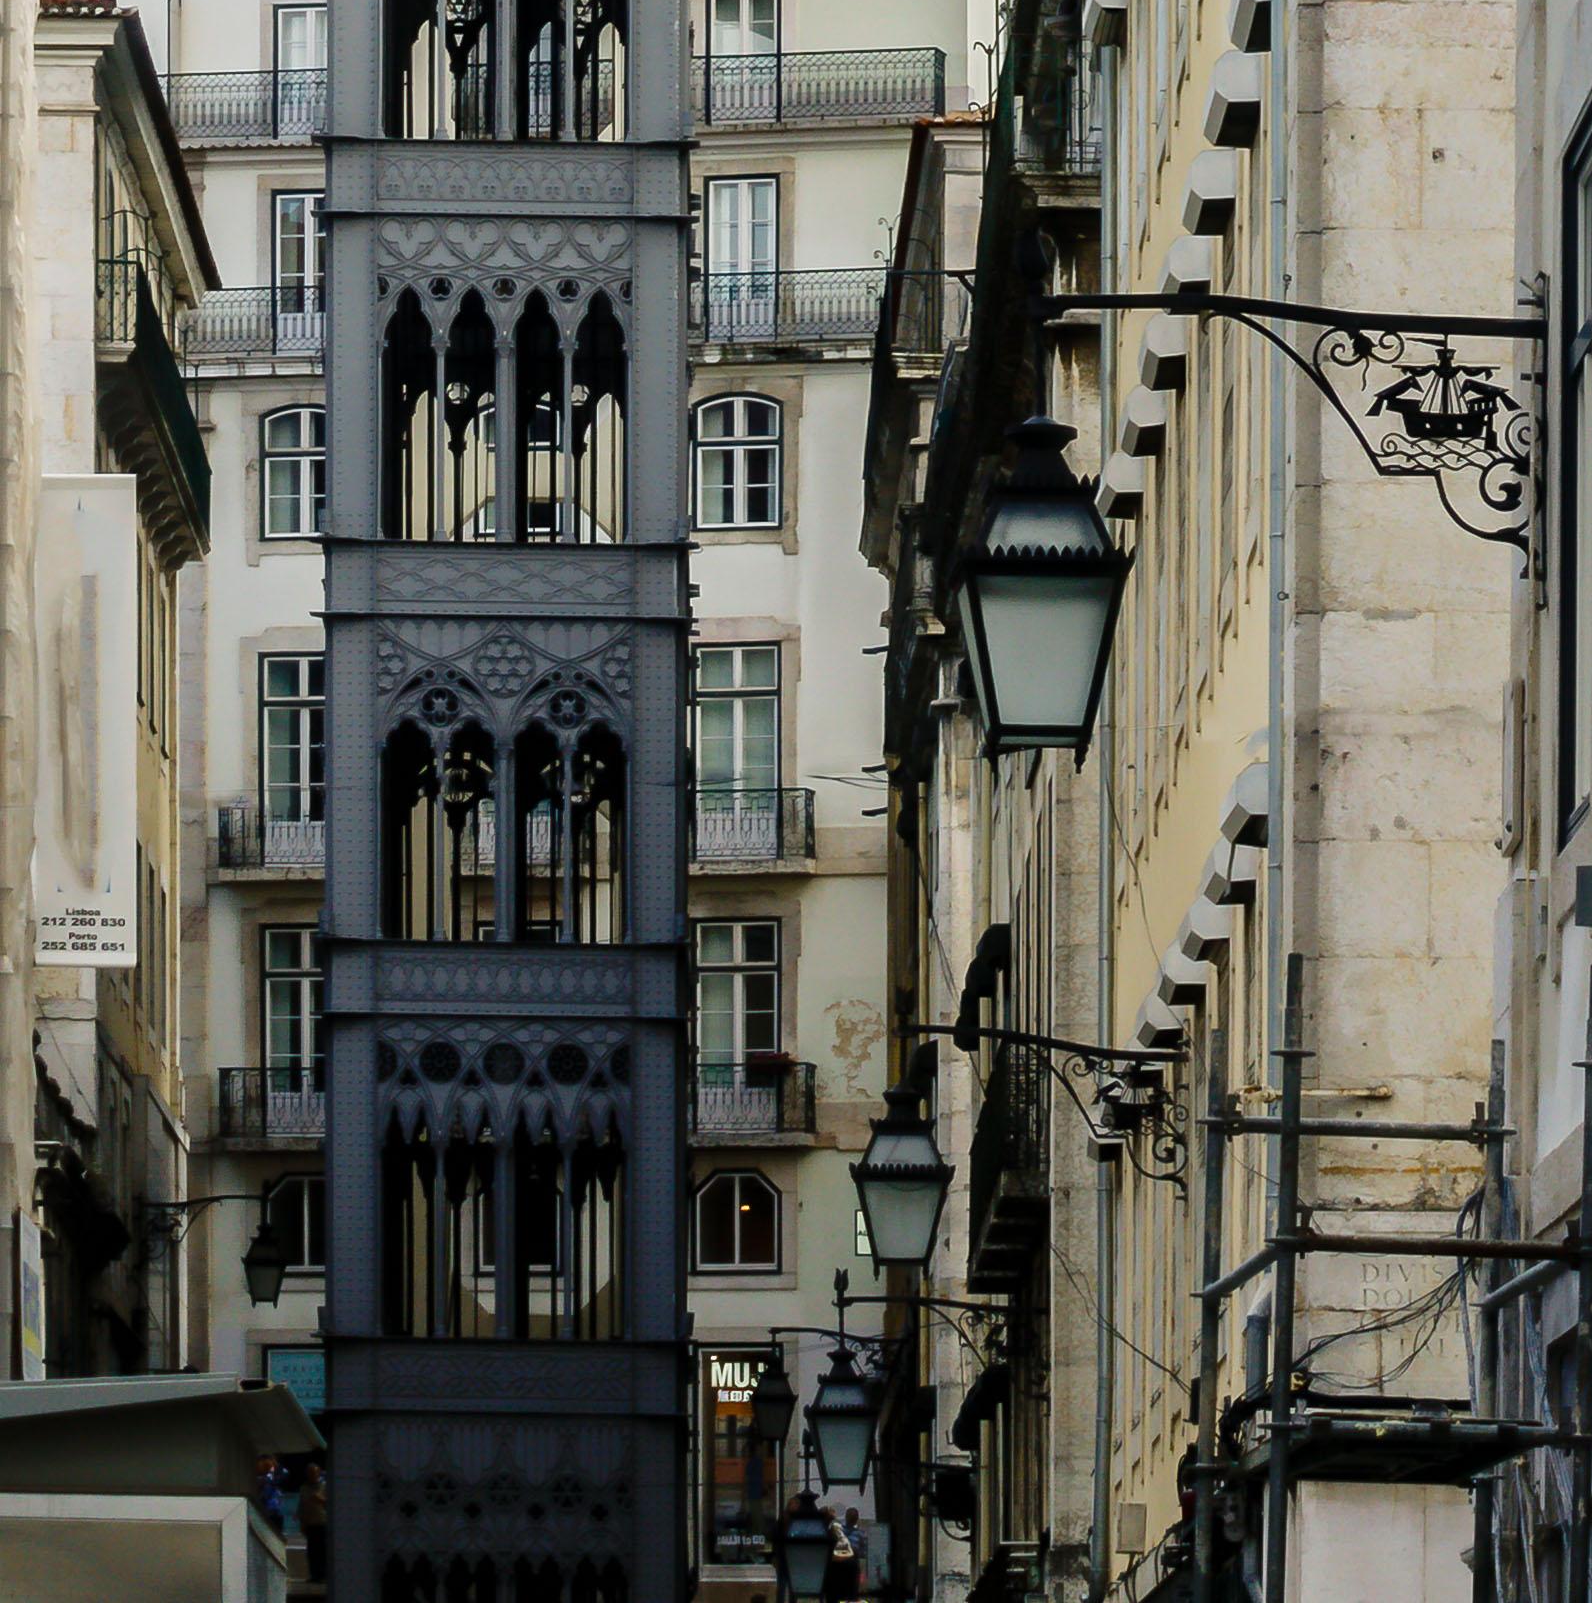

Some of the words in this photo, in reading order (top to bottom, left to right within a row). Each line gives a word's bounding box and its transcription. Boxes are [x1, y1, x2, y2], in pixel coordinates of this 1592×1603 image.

[65, 908, 101, 916] Lisboa
[41, 917, 66, 926] 212
[71, 917, 96, 926] 260
[101, 918, 126, 927] 830
[68, 932, 98, 940] Porto
[41, 941, 67, 950] 252
[71, 942, 97, 951] 685
[101, 942, 125, 951] 651
[711, 1362, 769, 1387] MUJ
